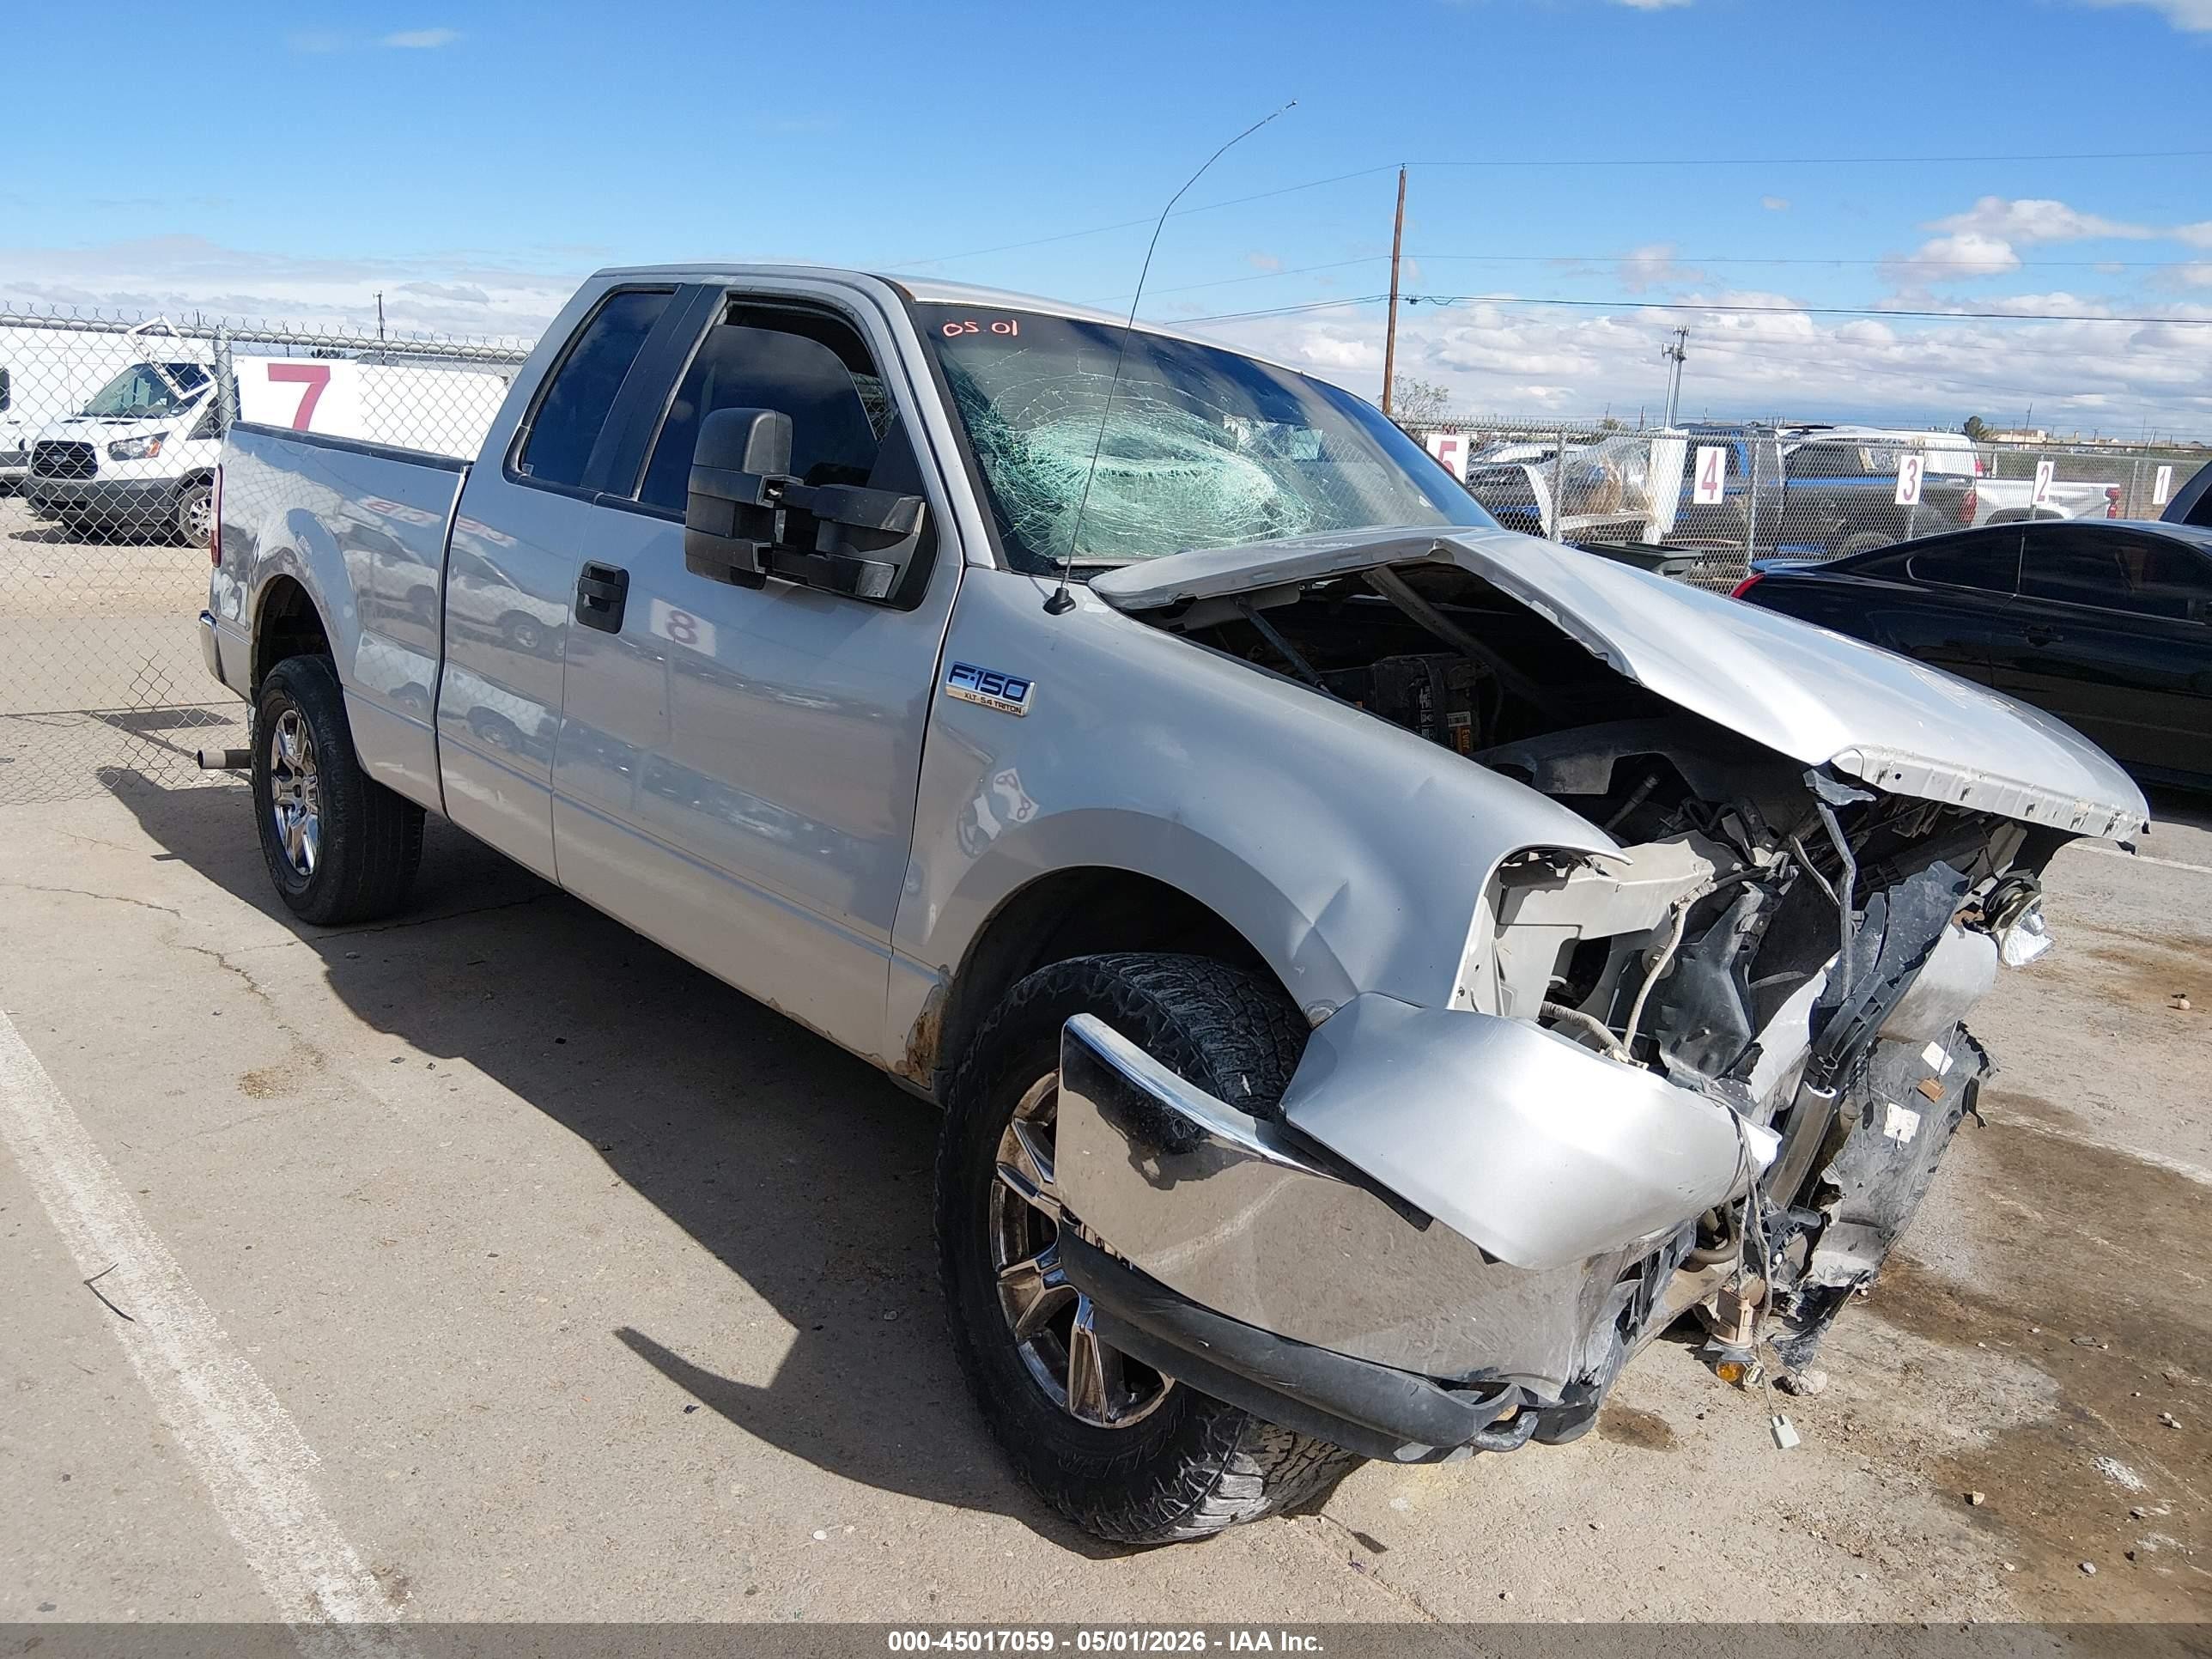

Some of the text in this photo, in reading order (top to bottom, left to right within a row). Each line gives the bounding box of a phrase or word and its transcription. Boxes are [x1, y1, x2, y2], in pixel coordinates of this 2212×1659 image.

[267, 362, 331, 432] 7
[1438, 440, 1457, 476] 5
[1701, 450, 1717, 500] 4
[1903, 459, 1917, 501] 3
[2036, 465, 2050, 501] 2
[2159, 468, 2166, 501] 1
[963, 691, 977, 701] XLT
[994, 700, 1022, 714] TRITON
